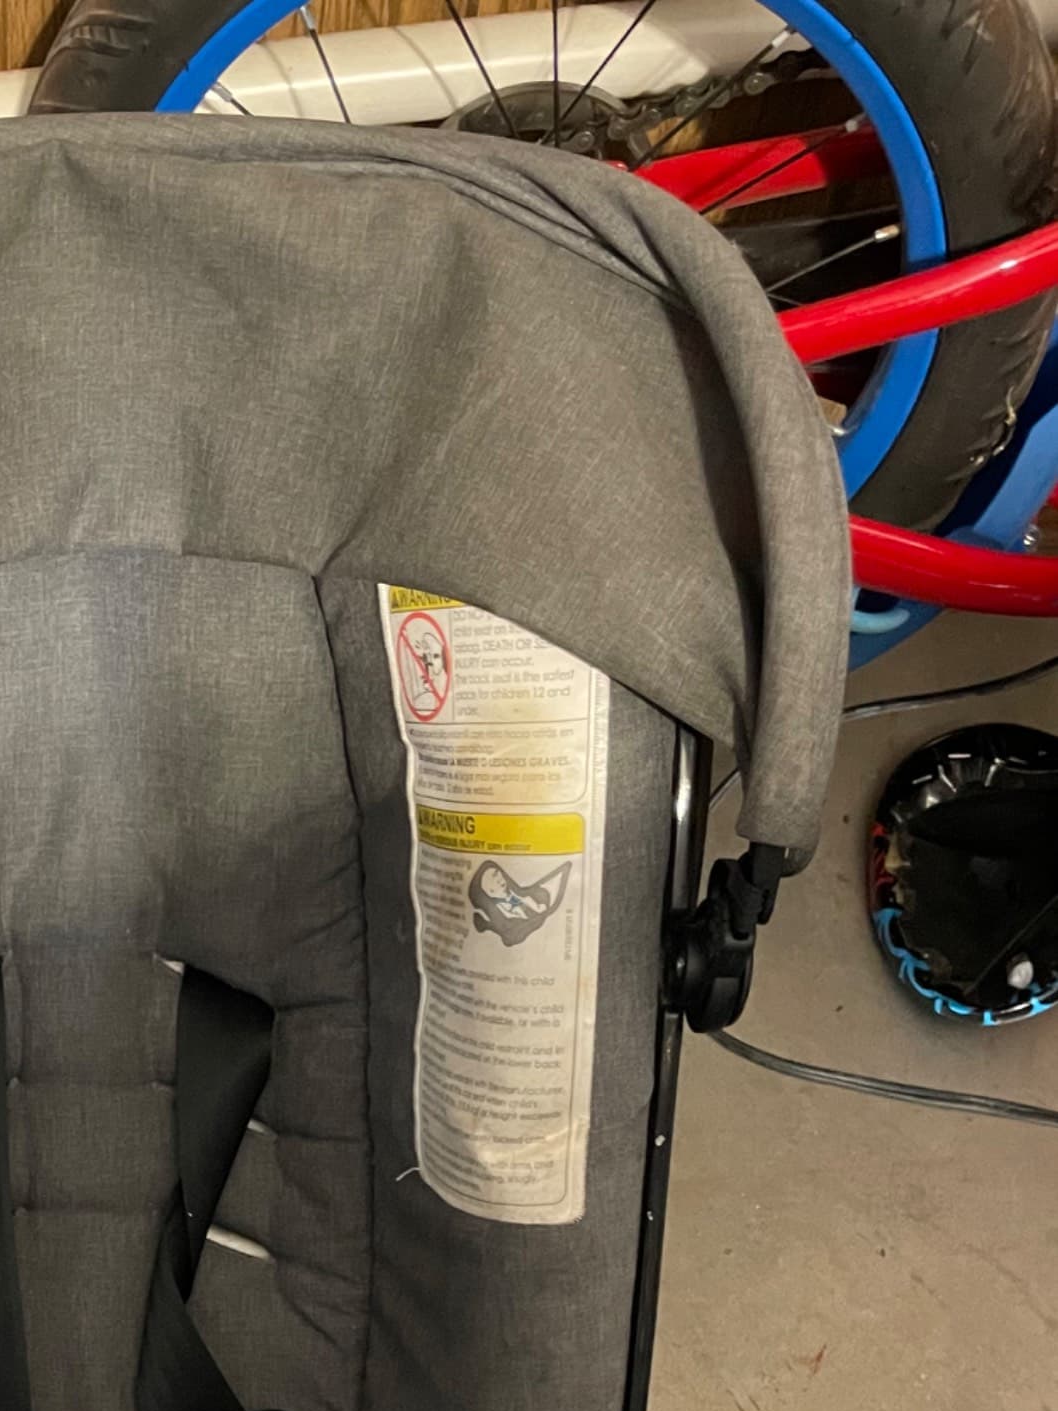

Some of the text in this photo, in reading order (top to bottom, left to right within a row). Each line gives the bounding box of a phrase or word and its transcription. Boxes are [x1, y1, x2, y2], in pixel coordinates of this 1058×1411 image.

[482, 639, 513, 651] DEATH
[523, 671, 541, 682] the
[542, 669, 574, 681] safest
[533, 687, 545, 698] 12
[546, 686, 570, 696] and
[424, 811, 476, 834] WARNING
[530, 976, 555, 986] child
[539, 1004, 564, 1014] child
[534, 1058, 560, 1069] back
